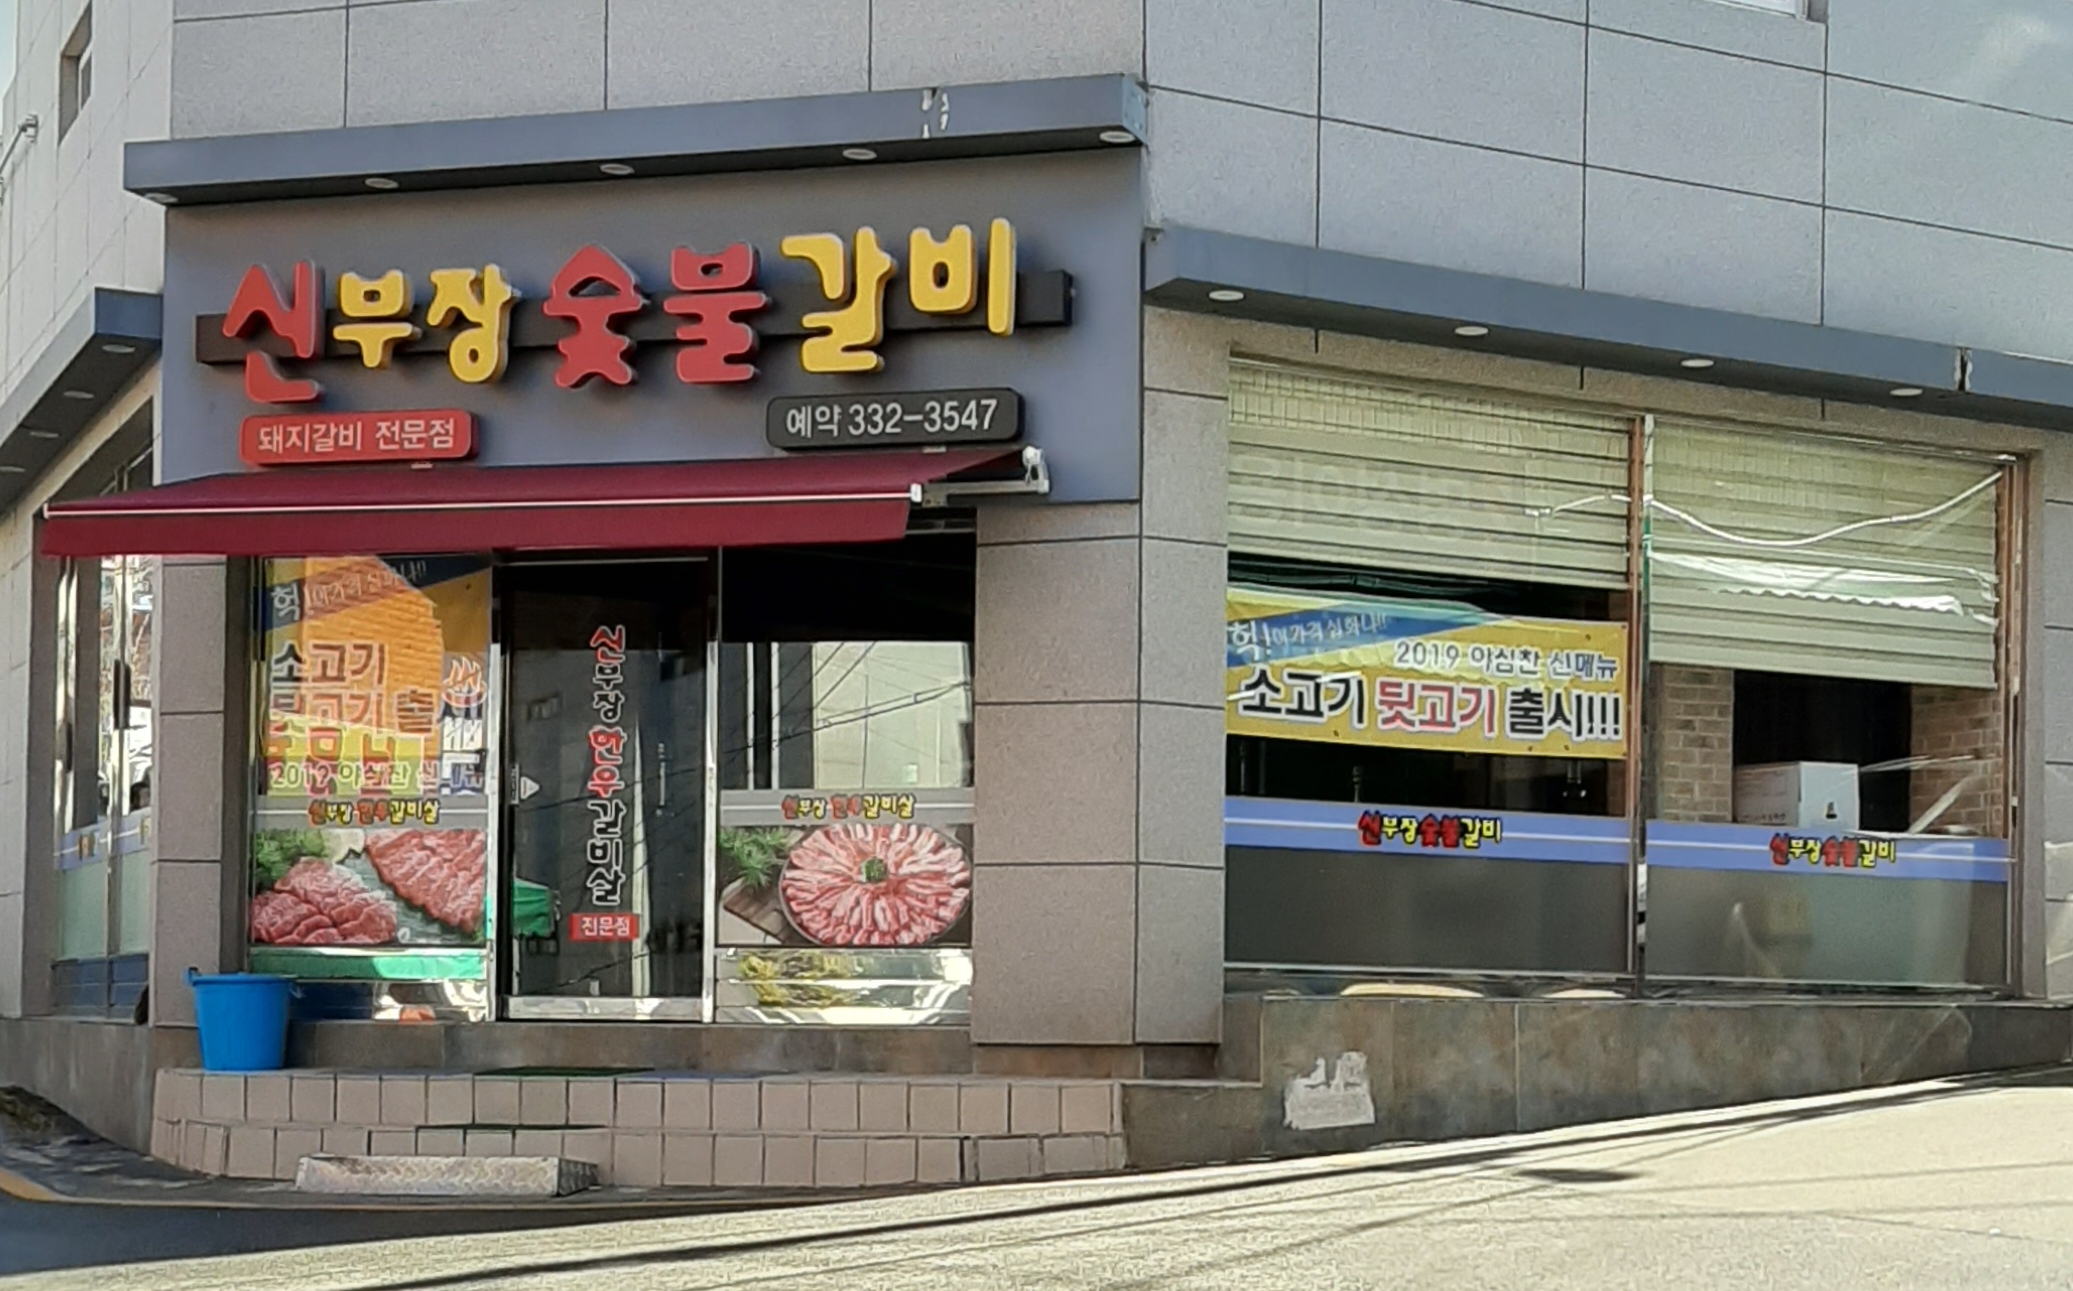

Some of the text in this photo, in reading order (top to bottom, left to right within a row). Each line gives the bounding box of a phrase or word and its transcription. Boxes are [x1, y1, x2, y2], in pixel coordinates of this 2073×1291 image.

[257, 416, 457, 453] 돼지갈비 전문점
[785, 398, 999, 439] 예약 332-3547
[271, 641, 386, 687] 소고기
[1395, 640, 1619, 680] 2019 야심찬 신메뉴
[1241, 667, 1366, 726] 소고기
[1379, 680, 1496, 736] 뒷고기
